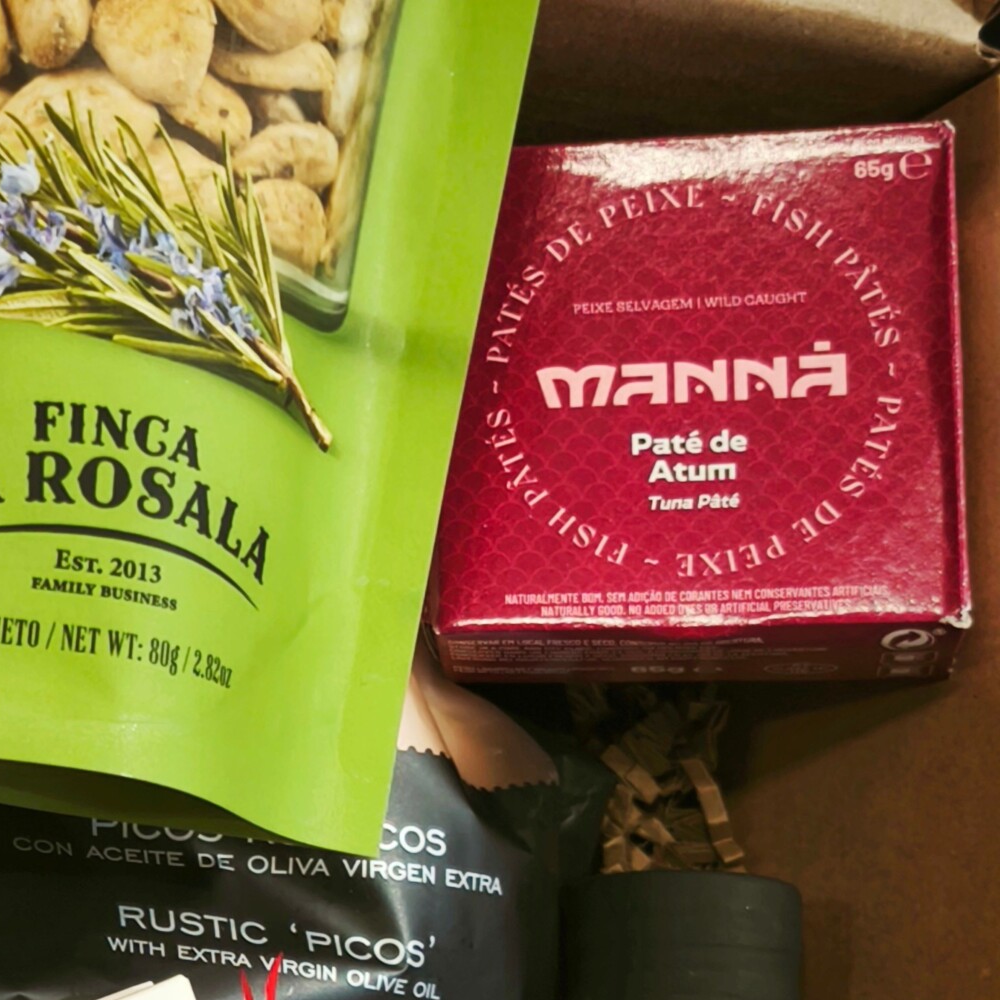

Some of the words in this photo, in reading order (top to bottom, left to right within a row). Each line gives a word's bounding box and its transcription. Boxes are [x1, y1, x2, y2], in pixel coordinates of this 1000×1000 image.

[854, 160, 894, 181] 65g
[752, 193, 833, 248] FISH
[486, 265, 546, 364] PATÉS
[546, 221, 592, 262] DE
[598, 184, 704, 228] PEIXE
[574, 302, 613, 315] PEIXE
[616, 299, 693, 312] SELVAGEM
[704, 295, 741, 308] WILD
[743, 292, 807, 306] CAUGHT
[33, 401, 201, 470] FINCA
[631, 430, 703, 455] Paté
[710, 429, 748, 452] de
[649, 460, 736, 483] Atum
[25, 451, 270, 585] ROSALA
[649, 496, 693, 511] Tuna
[698, 492, 740, 509] Pâté
[792, 500, 842, 543] DE
[549, 507, 628, 565] FISH
[676, 535, 787, 577] PEIXE
[110, 557, 162, 584] 2013
[31, 577, 96, 599] FAMILY
[100, 585, 178, 612] BUSINESS
[505, 592, 579, 605] NATURALMENTE
[606, 592, 625, 604] SEM
[665, 590, 677, 601] DE
[679, 589, 729, 602] CORANTES
[731, 588, 752, 600] NEM
[754, 586, 830, 600] CONSERVANTES
[541, 605, 595, 617] NATURALLY
[629, 604, 641, 616] NO
[644, 604, 676, 616] ADDED
[704, 602, 718, 614] OR
[720, 600, 771, 613] ARTIFICIAL
[61, 624, 101, 655] NET
[107, 629, 143, 662] WT:
[149, 637, 179, 676] 80g
[13, 836, 73, 856] CON
[85, 845, 186, 867] ACEITE
[198, 853, 235, 872] DE
[247, 856, 330, 877] OLIVA
[343, 859, 436, 885] VIRGEN
[445, 869, 503, 896] EXTRA
[118, 904, 269, 945] RUSTIC
[107, 936, 166, 958] WITH
[177, 947, 252, 968] EXTRA
[346, 969, 408, 996] OLIVE
[412, 981, 441, 1000] OIL
